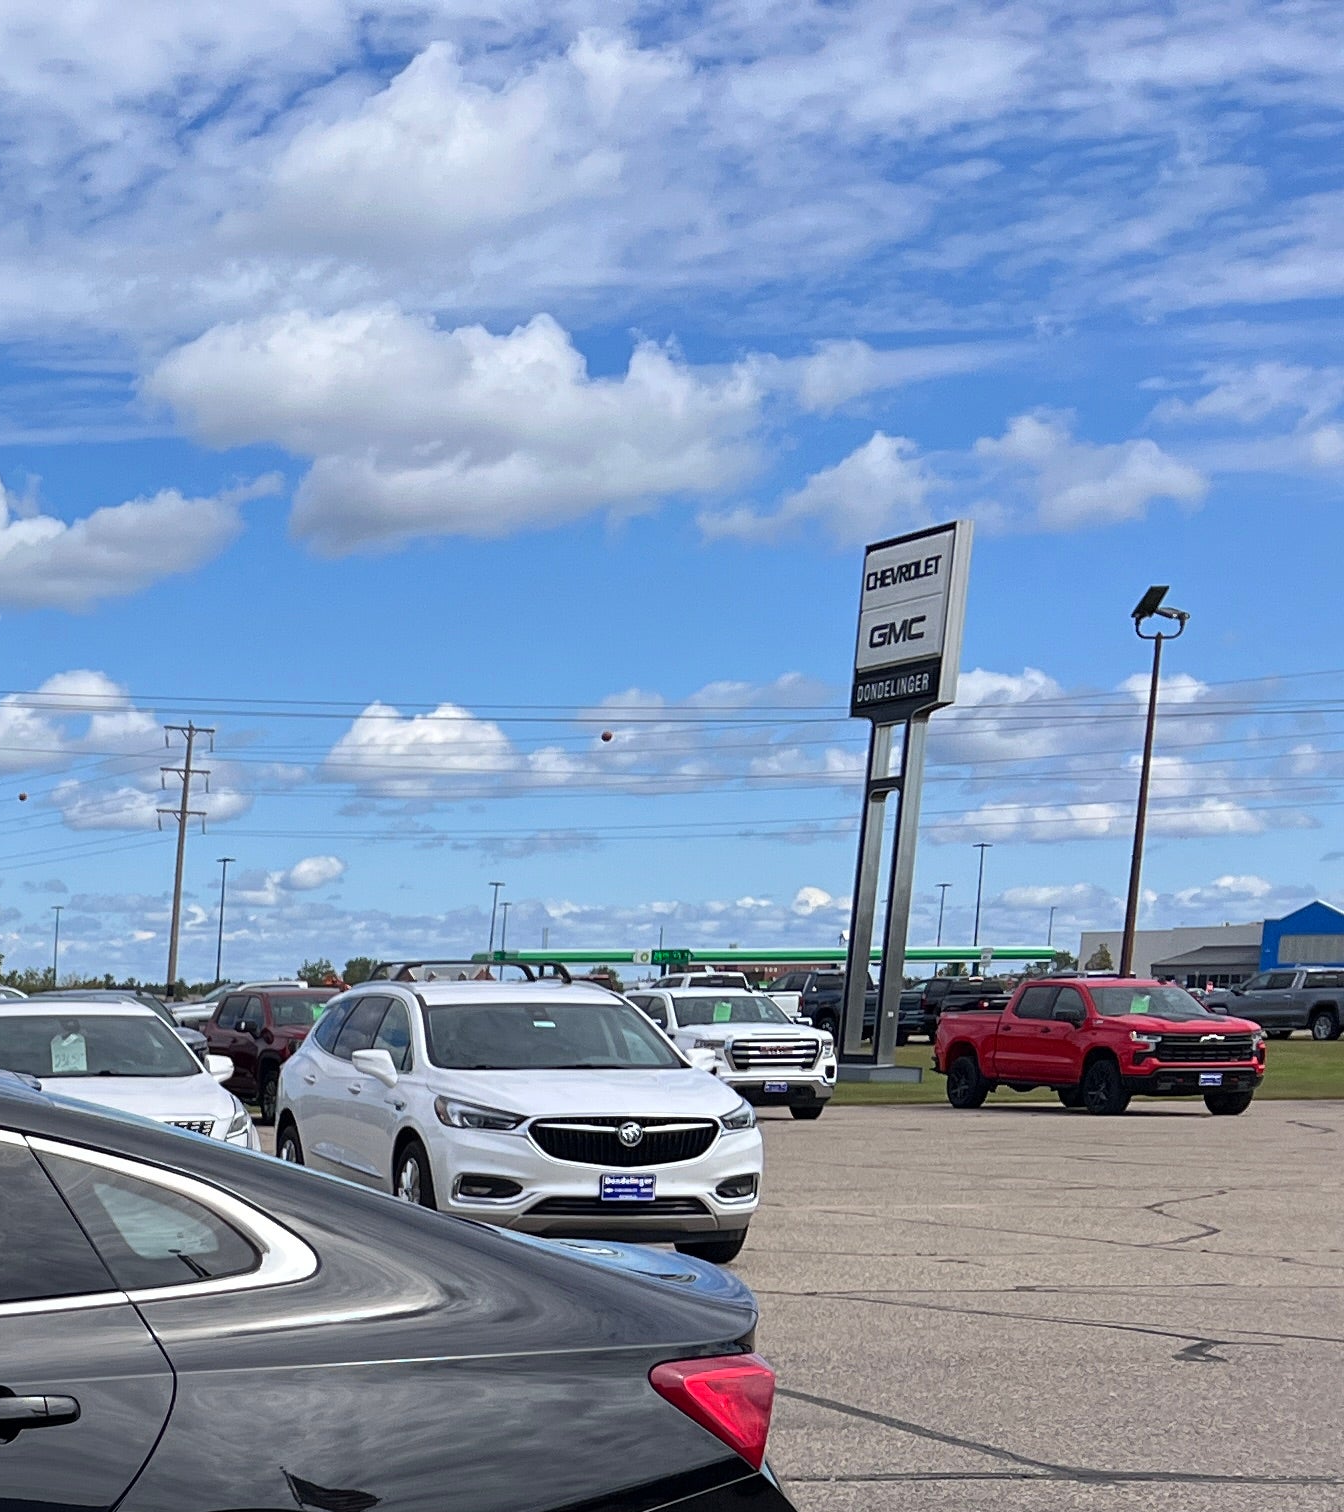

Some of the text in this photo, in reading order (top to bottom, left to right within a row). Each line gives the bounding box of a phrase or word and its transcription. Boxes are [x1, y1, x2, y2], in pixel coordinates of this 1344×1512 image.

[866, 555, 942, 591] CHEVROLET
[869, 615, 926, 648] GMC
[857, 673, 929, 702] DONDELINGER
